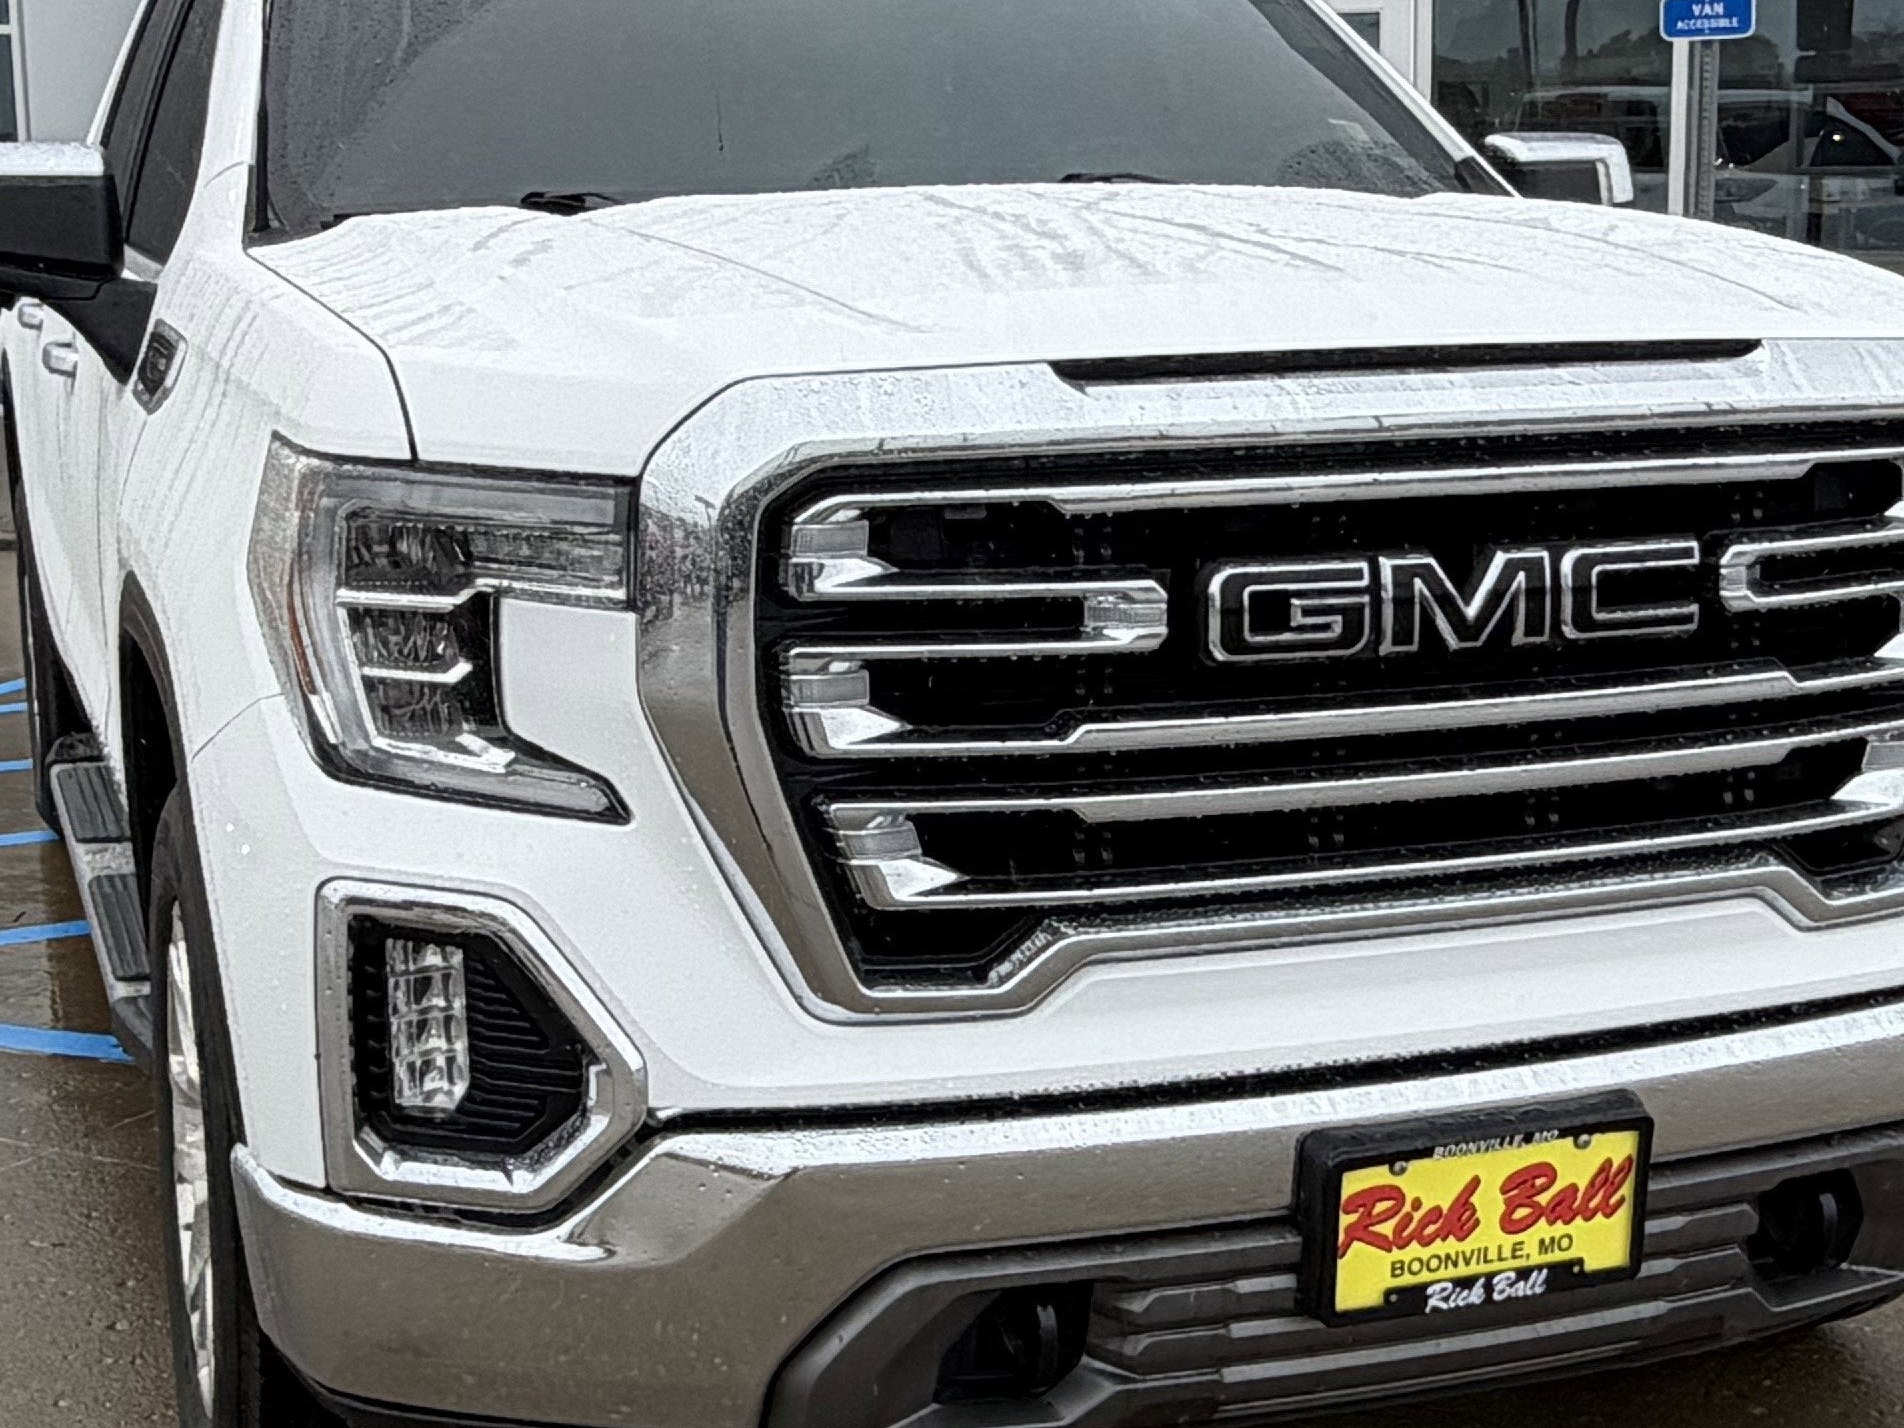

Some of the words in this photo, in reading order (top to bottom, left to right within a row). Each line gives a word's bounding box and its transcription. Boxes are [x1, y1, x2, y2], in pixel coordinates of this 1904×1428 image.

[1692, 2, 1724, 16] VAN
[1208, 540, 1699, 662] GMC
[1338, 1174, 1482, 1258] Rick
[1499, 1154, 1634, 1235] Ball
[1390, 1239, 1531, 1278] BOONVILLE,
[1538, 1233, 1574, 1255] MO
[1424, 1280, 1486, 1314] Rick
[1492, 1269, 1549, 1301] Ball
